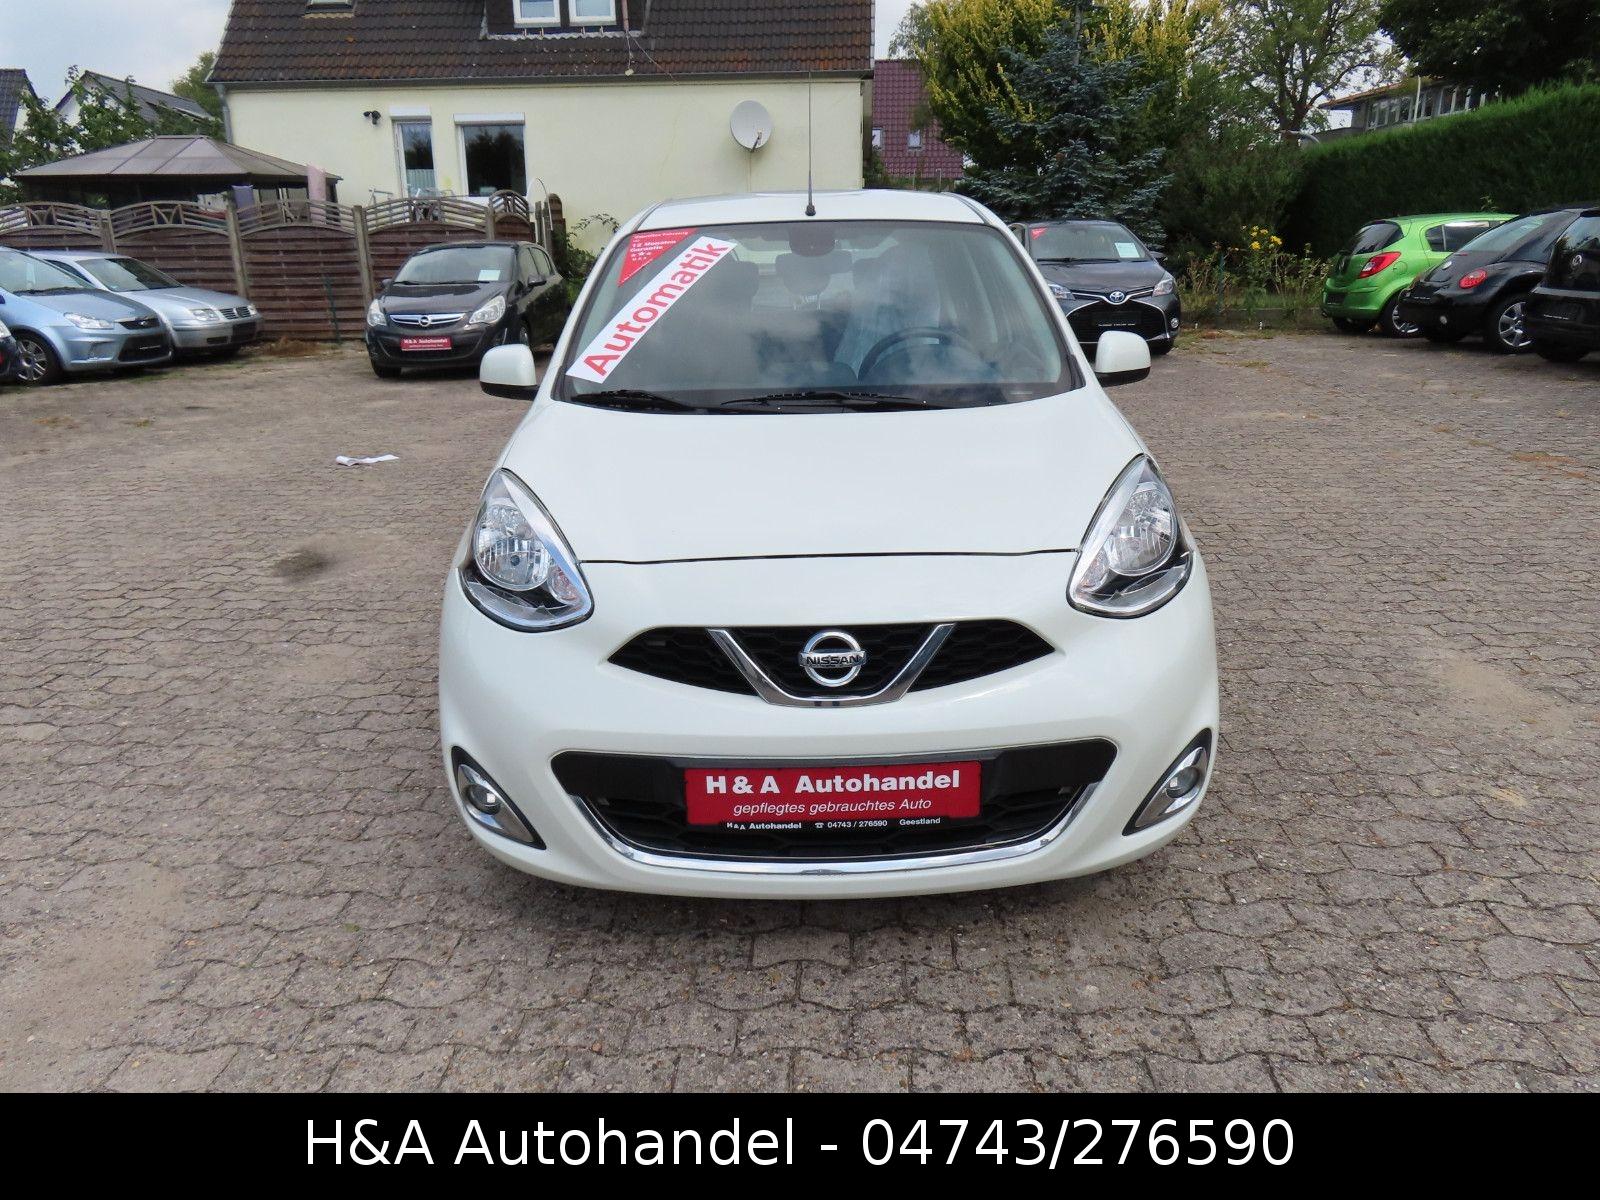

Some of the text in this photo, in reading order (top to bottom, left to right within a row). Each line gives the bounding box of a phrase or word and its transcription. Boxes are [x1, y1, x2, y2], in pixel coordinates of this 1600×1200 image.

[583, 242, 730, 377] Automatik
[806, 654, 860, 665] NISSAN
[794, 769, 960, 793] Autohandel
[733, 798, 932, 817] gepflegtes gebrauchtes Auto
[748, 822, 802, 830] Autohandel
[827, 820, 852, 829] 04743
[858, 819, 888, 828] 276590
[899, 817, 941, 826] Geestland
